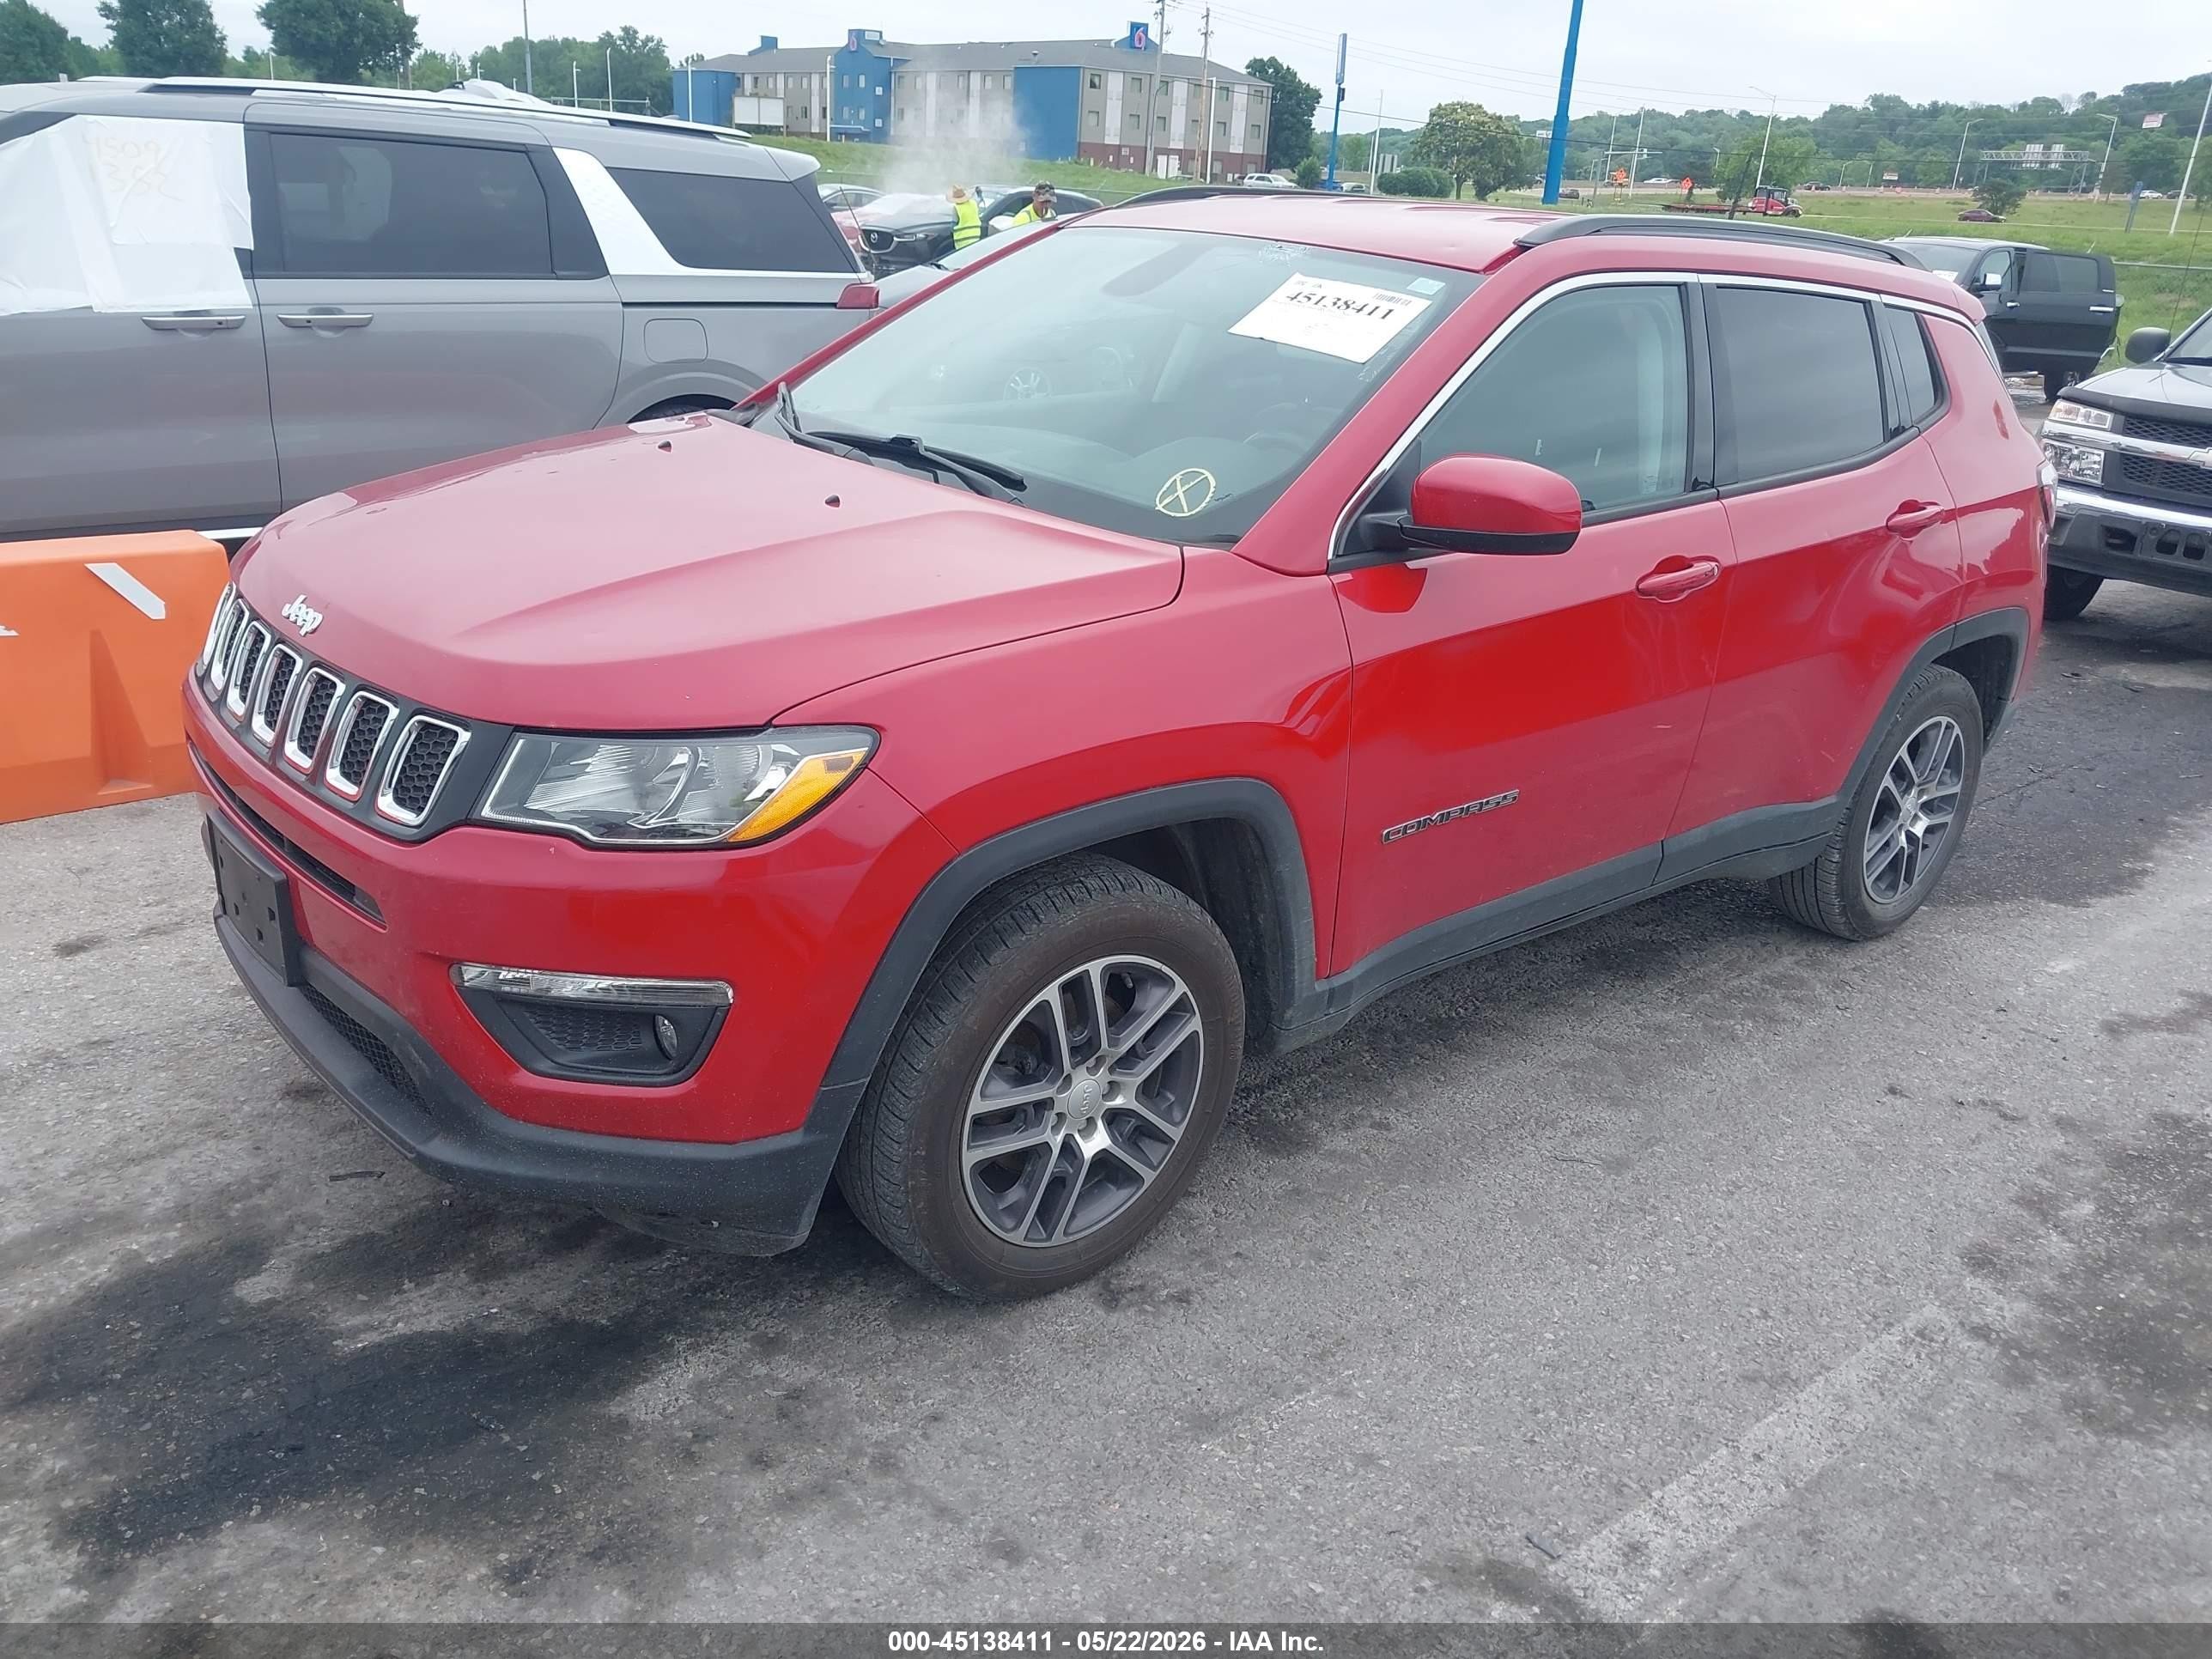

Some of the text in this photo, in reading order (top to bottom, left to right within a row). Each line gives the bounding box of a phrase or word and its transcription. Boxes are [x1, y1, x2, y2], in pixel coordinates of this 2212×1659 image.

[1134, 27, 1146, 48] 6
[1285, 291, 1395, 320] 45138411
[281, 593, 324, 637] Jeep
[1381, 788, 1520, 845] COMPASS
